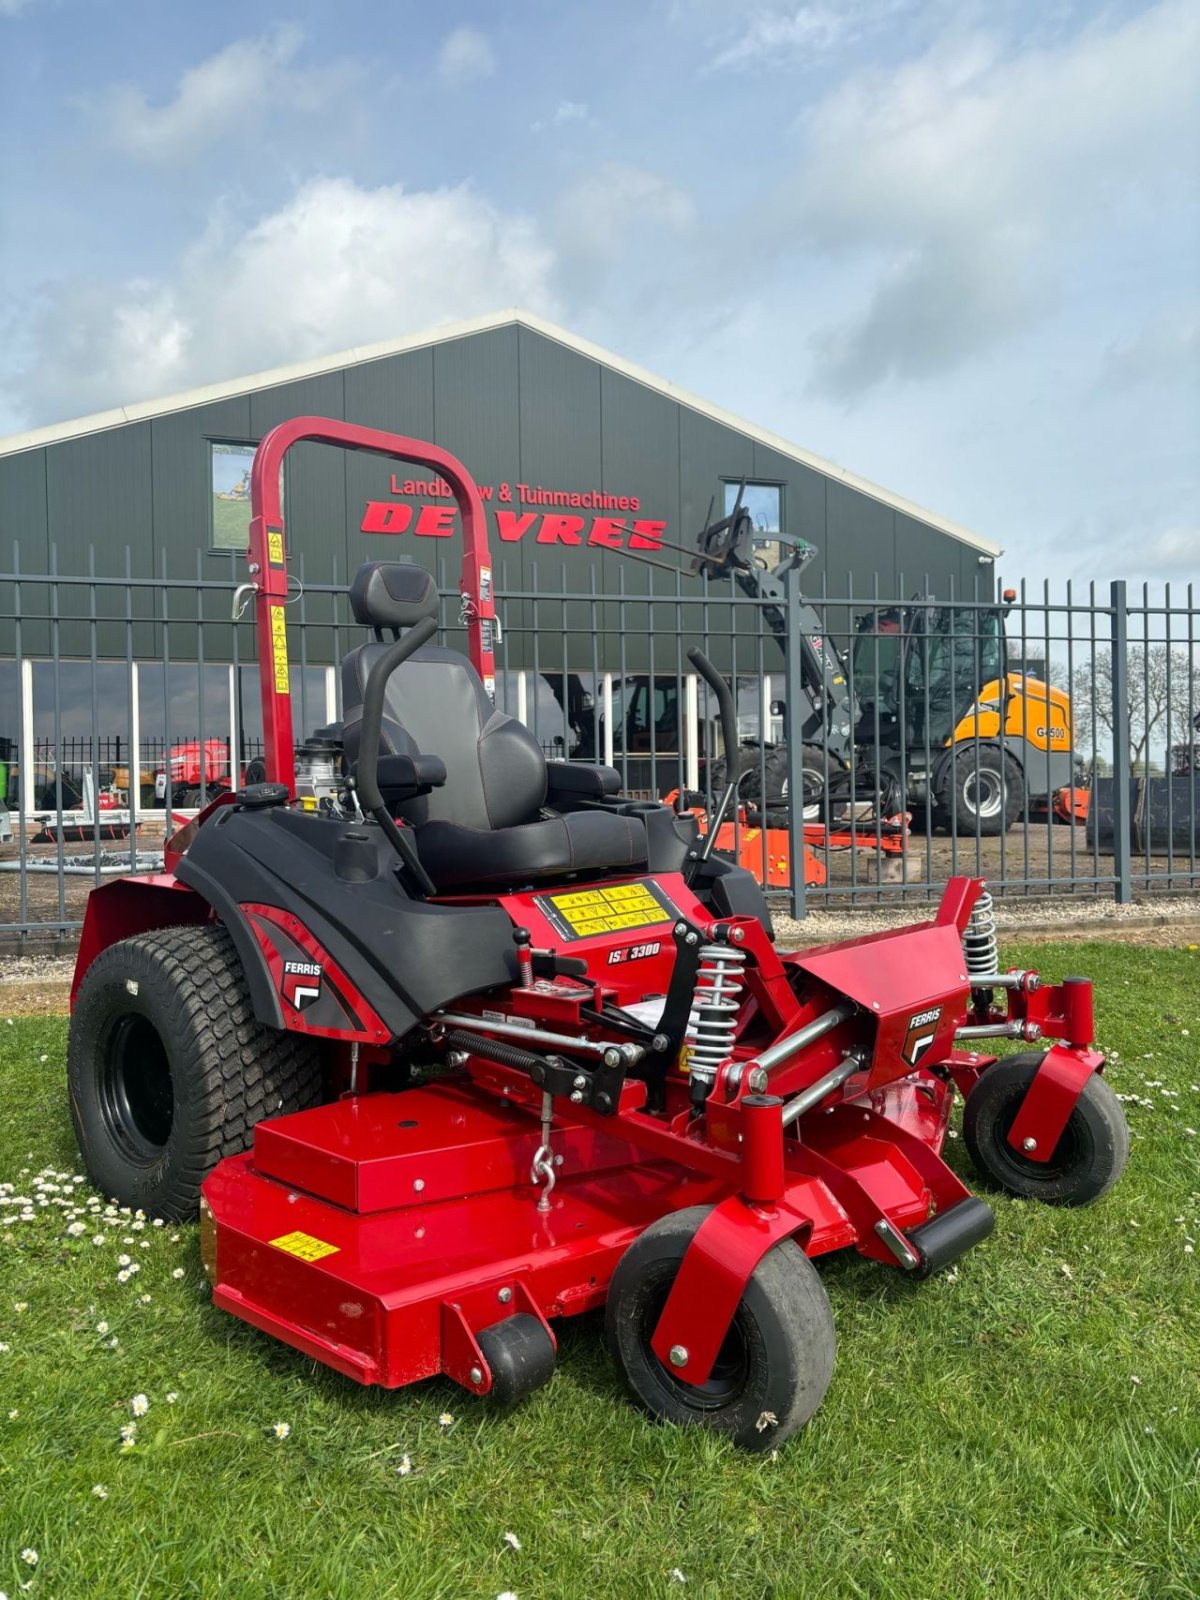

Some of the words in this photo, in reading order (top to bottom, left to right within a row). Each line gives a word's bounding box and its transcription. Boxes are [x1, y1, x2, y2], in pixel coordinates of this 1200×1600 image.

[391, 474, 493, 500] Landbw
[498, 482, 512, 502] &
[517, 484, 640, 511] Tuinmachines
[361, 501, 458, 537] DE
[495, 510, 667, 550] VREE
[630, 942, 660, 959] 3300
[285, 961, 321, 976] FERRIS
[910, 1008, 941, 1029] FERRIS
